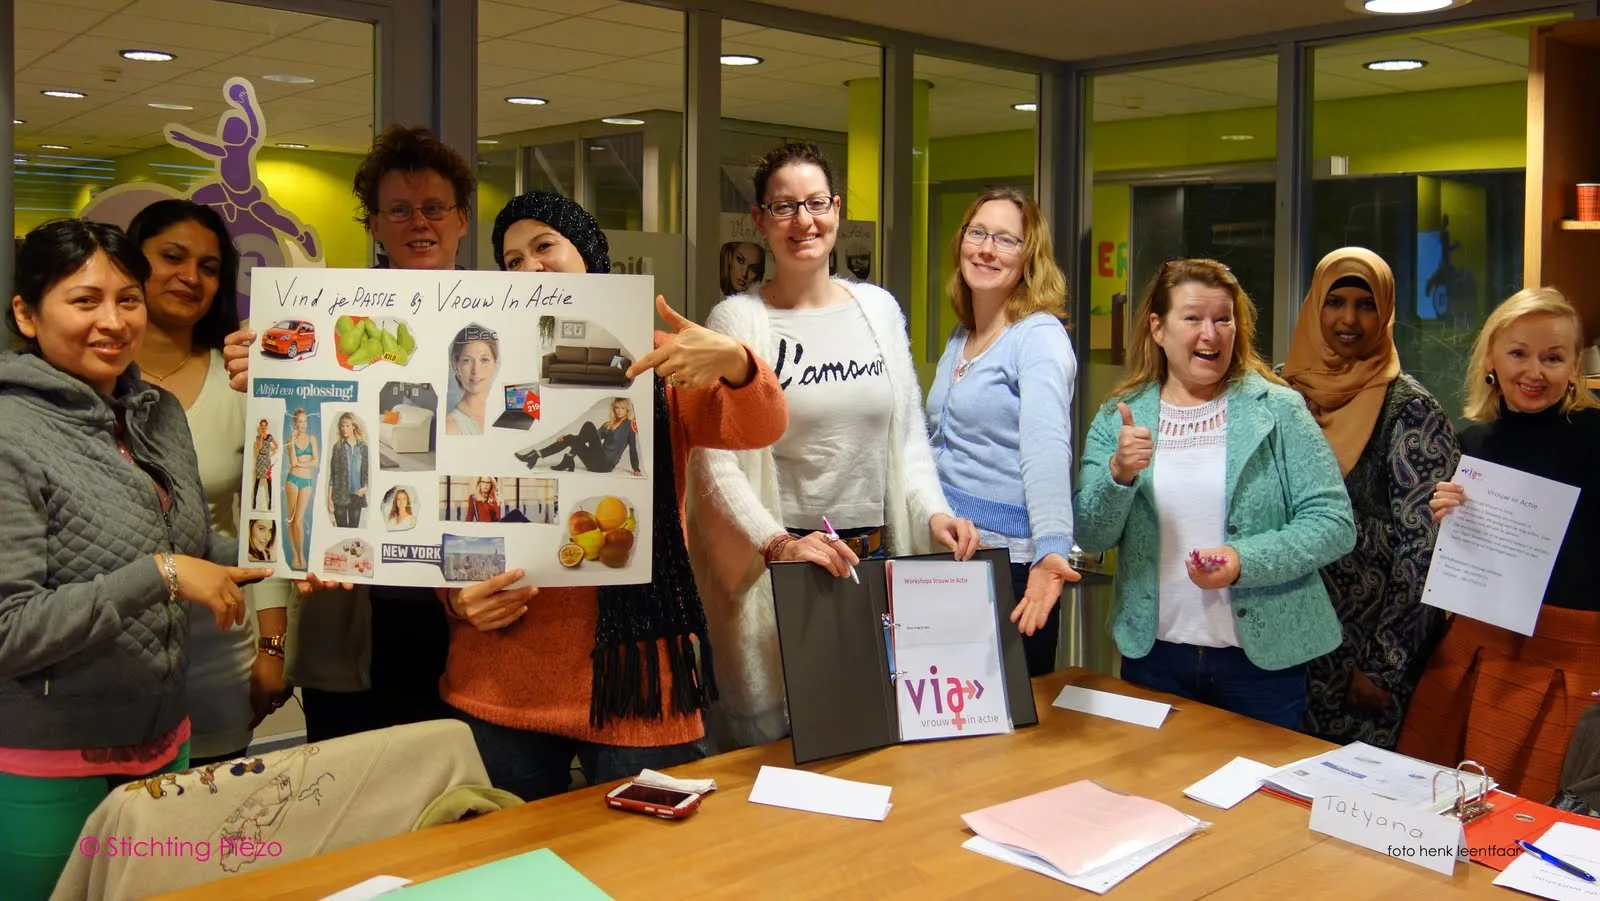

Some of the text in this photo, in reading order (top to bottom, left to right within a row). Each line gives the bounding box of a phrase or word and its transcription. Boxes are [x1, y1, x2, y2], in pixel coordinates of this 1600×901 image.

[275, 276, 324, 308] Vind
[328, 293, 350, 316] je
[352, 286, 397, 308] PASSIE
[501, 284, 519, 311] In
[525, 284, 574, 308] Actie
[256, 383, 354, 401] Altijd een oplossing!
[1487, 489, 1511, 501] Vrouw
[1520, 499, 1538, 509] Actie
[383, 544, 441, 560] NEW YORK
[904, 665, 965, 716] via
[921, 714, 999, 727] vrouw in actie
[1321, 795, 1423, 839] Tatyana
